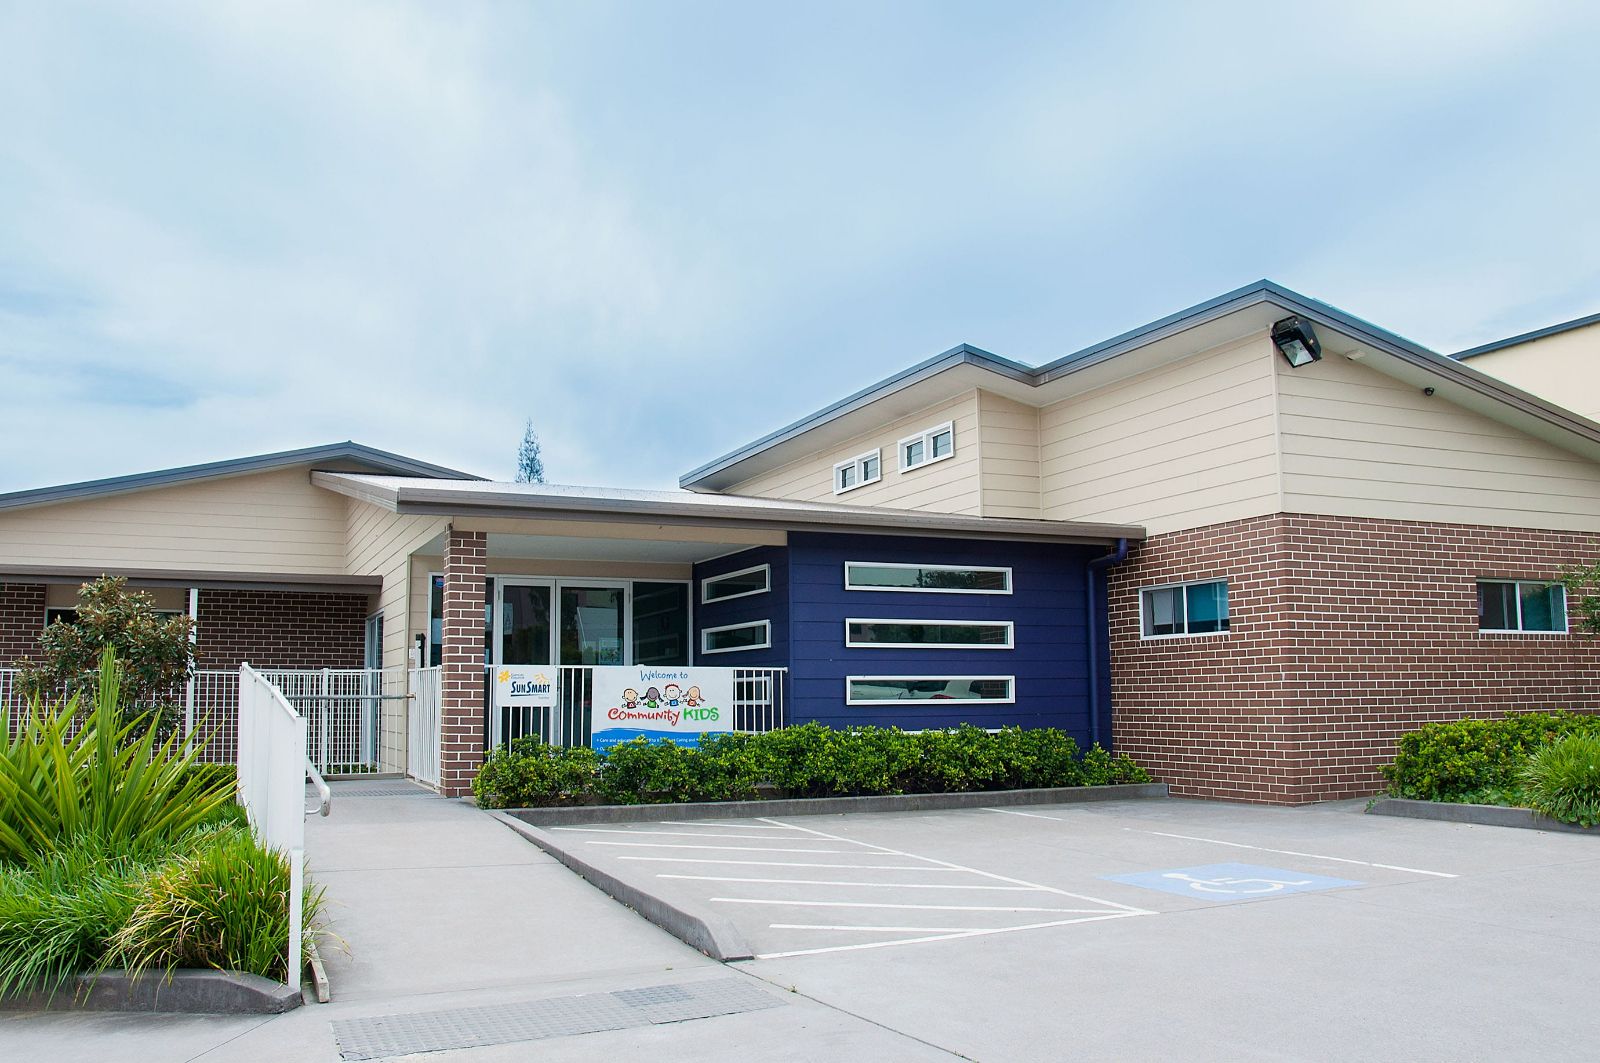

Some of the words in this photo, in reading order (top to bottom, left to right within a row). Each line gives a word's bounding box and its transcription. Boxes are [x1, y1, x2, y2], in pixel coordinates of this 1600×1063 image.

[640, 670, 677, 682] Welcome
[679, 672, 688, 680] to
[608, 708, 680, 726] Community
[683, 707, 720, 722] KIDS
